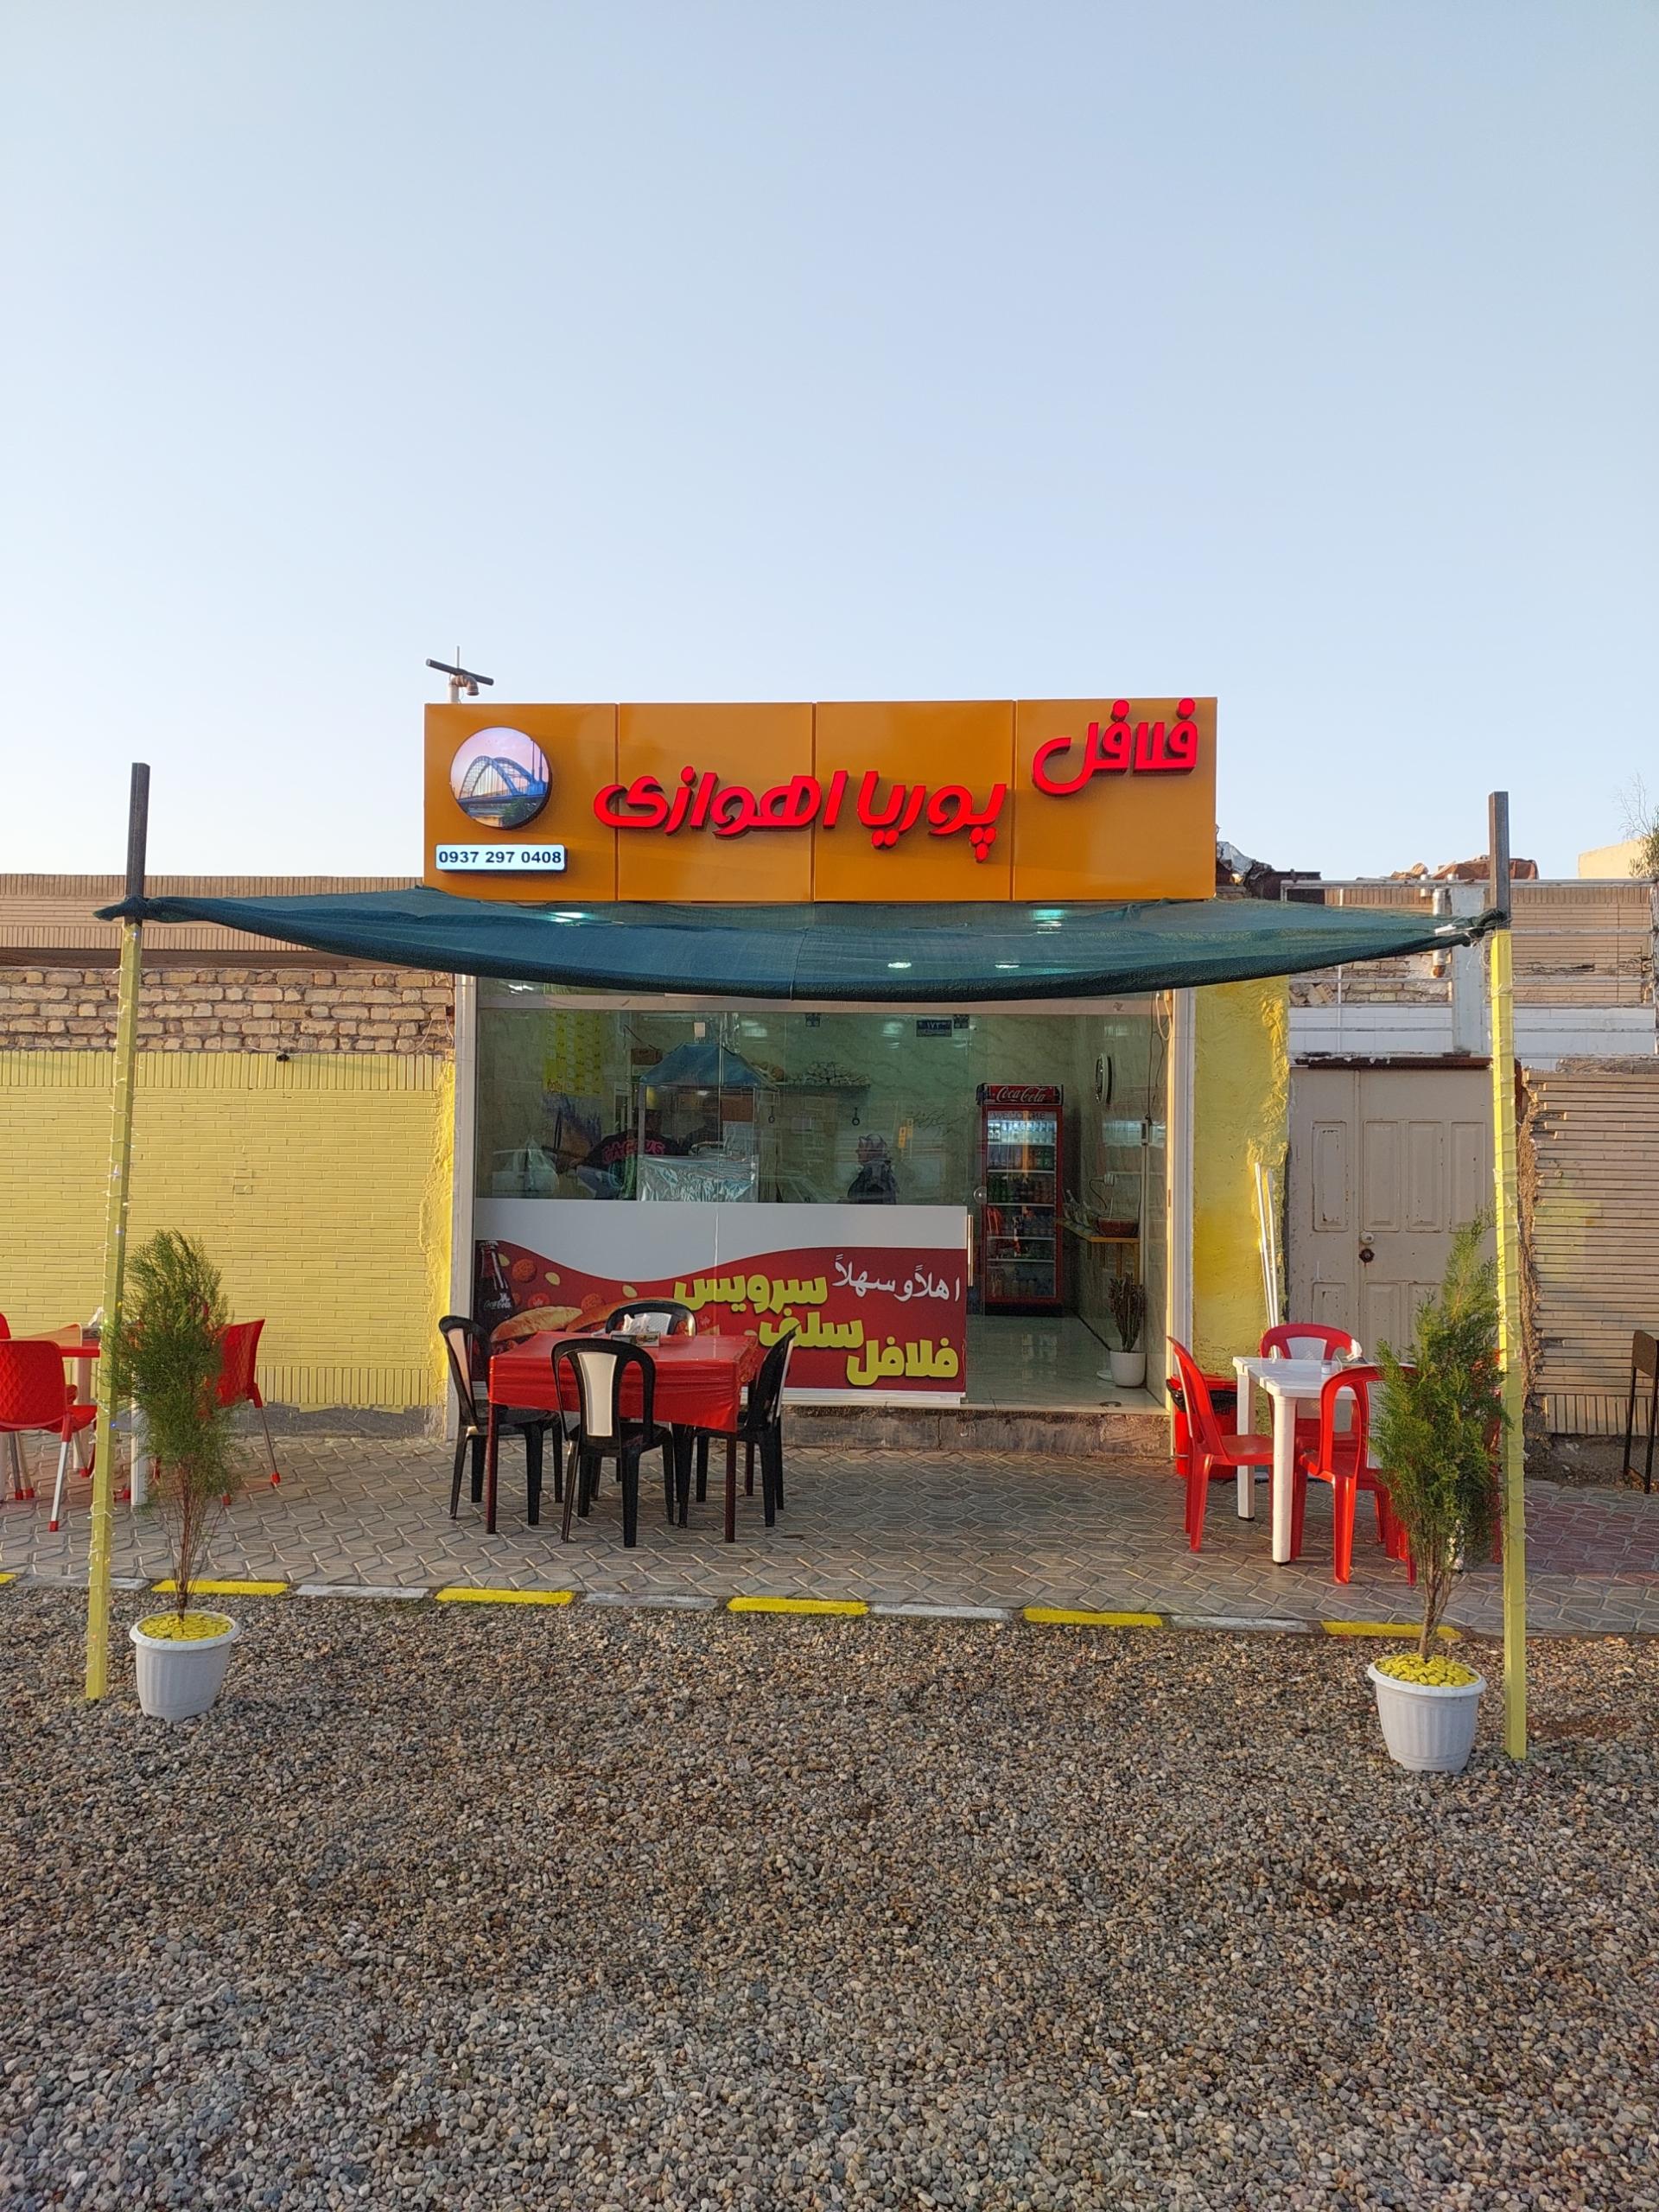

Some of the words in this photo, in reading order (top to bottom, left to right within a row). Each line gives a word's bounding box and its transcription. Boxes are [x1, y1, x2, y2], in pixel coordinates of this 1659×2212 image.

[1032, 697, 1198, 795] فلافل
[594, 766, 848, 837] اهوازی
[856, 770, 1007, 862] پوریا
[438, 851, 480, 863] 0937
[485, 851, 515, 863] 297
[521, 851, 563, 863] 0408
[996, 1085, 1046, 1103] Coca-Cola
[673, 1274, 828, 1314] سرویس
[759, 1307, 864, 1349] سلف
[846, 1335, 959, 1387] فلافل
